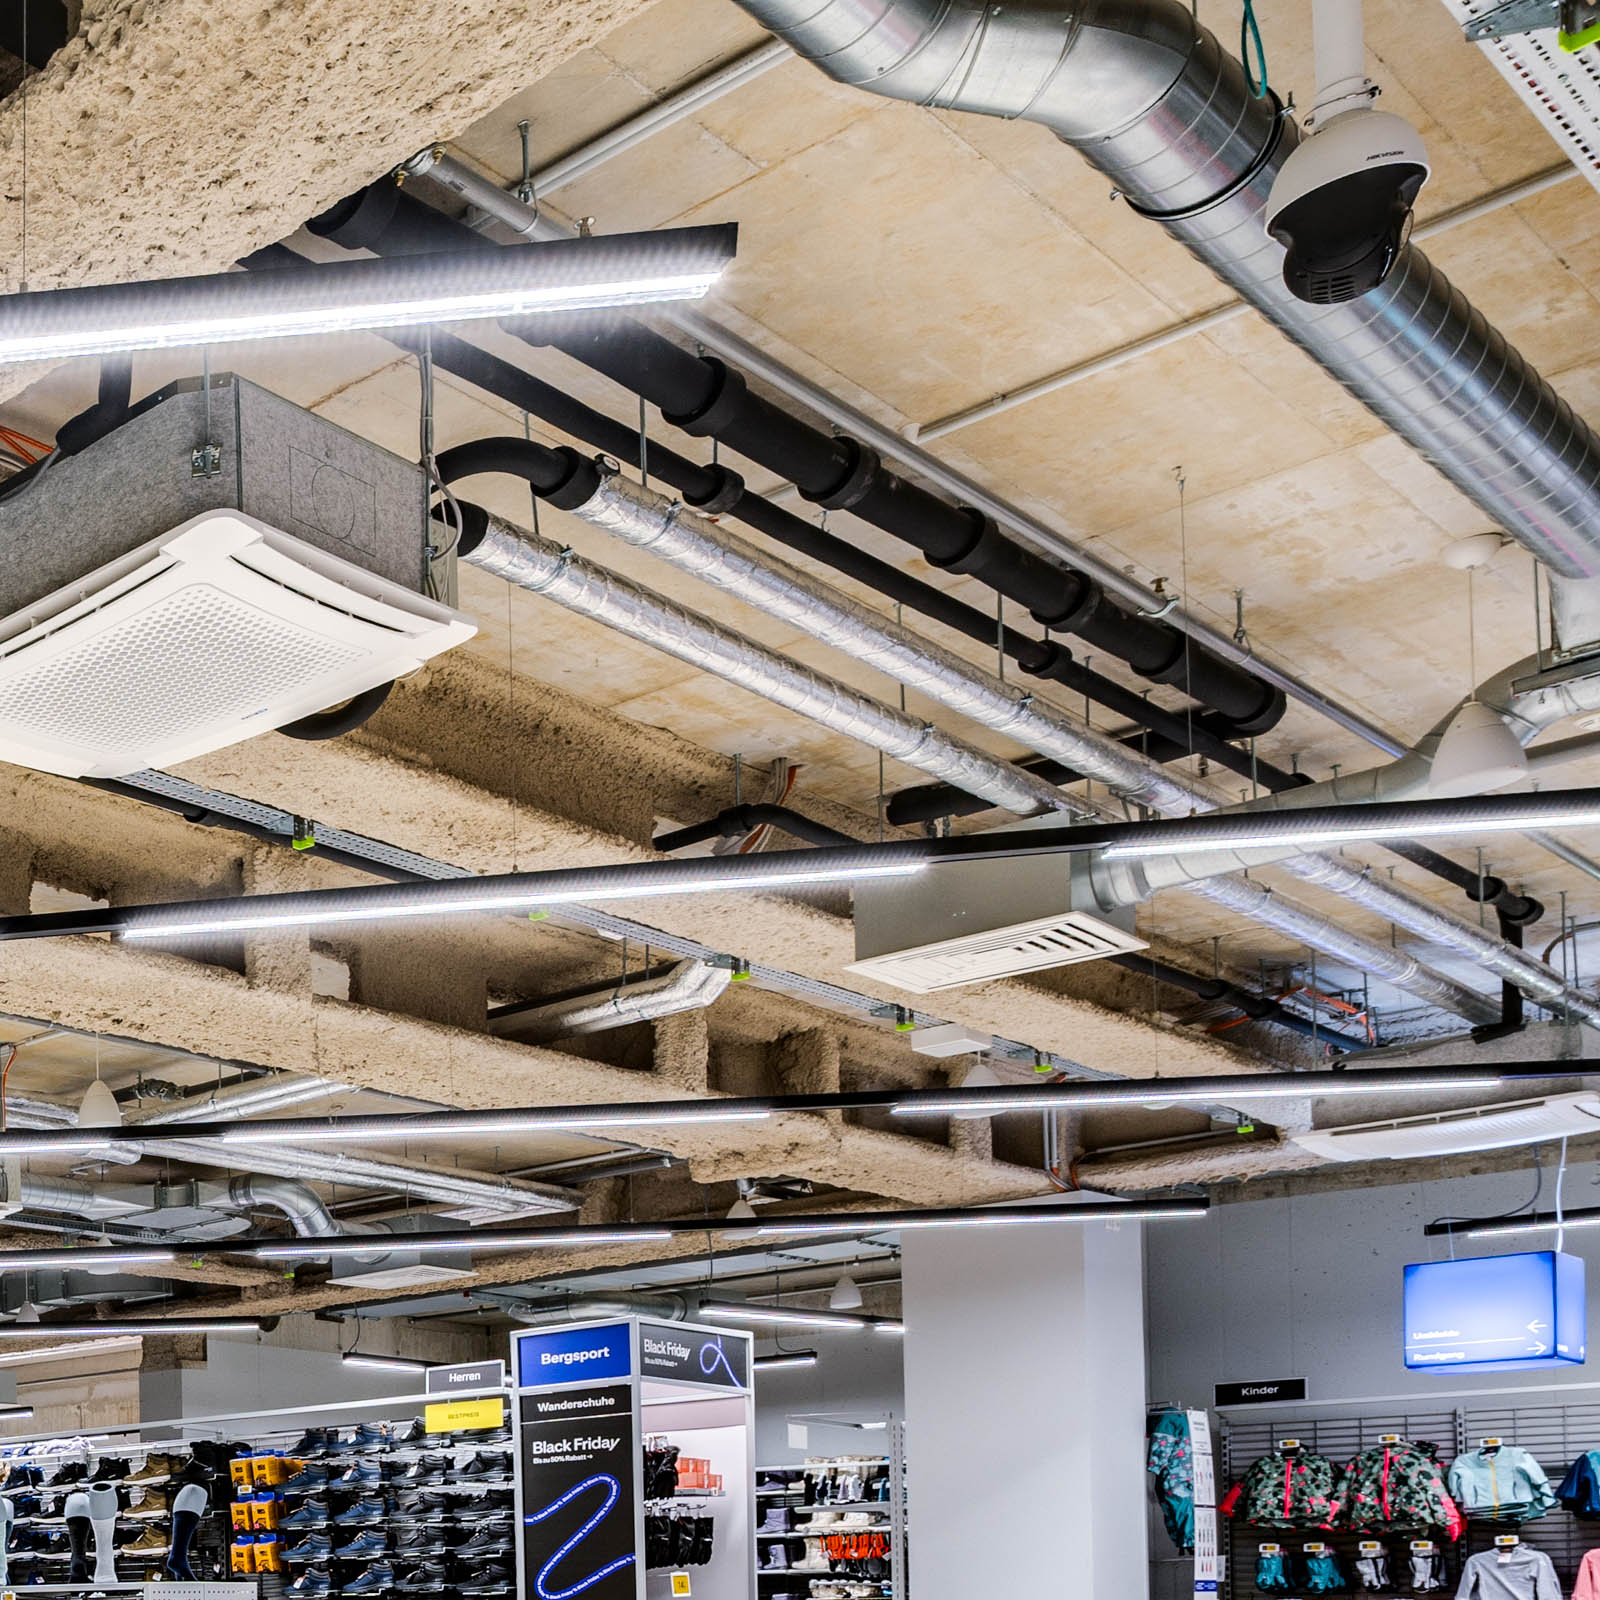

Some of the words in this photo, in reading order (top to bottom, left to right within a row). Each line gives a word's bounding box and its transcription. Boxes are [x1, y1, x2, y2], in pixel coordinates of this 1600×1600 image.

[541, 1346, 610, 1365] Bergsport
[643, 1338, 666, 1354] Black
[666, 1341, 691, 1361] Friday
[449, 1373, 481, 1382] Herren
[1242, 1386, 1280, 1396] Kinder
[537, 1396, 615, 1413] Wanderschuhe
[532, 1439, 572, 1455] Black
[573, 1437, 621, 1452] Friday
[550, 1455, 565, 1464] 50%
[565, 1453, 587, 1462] Rabatt
